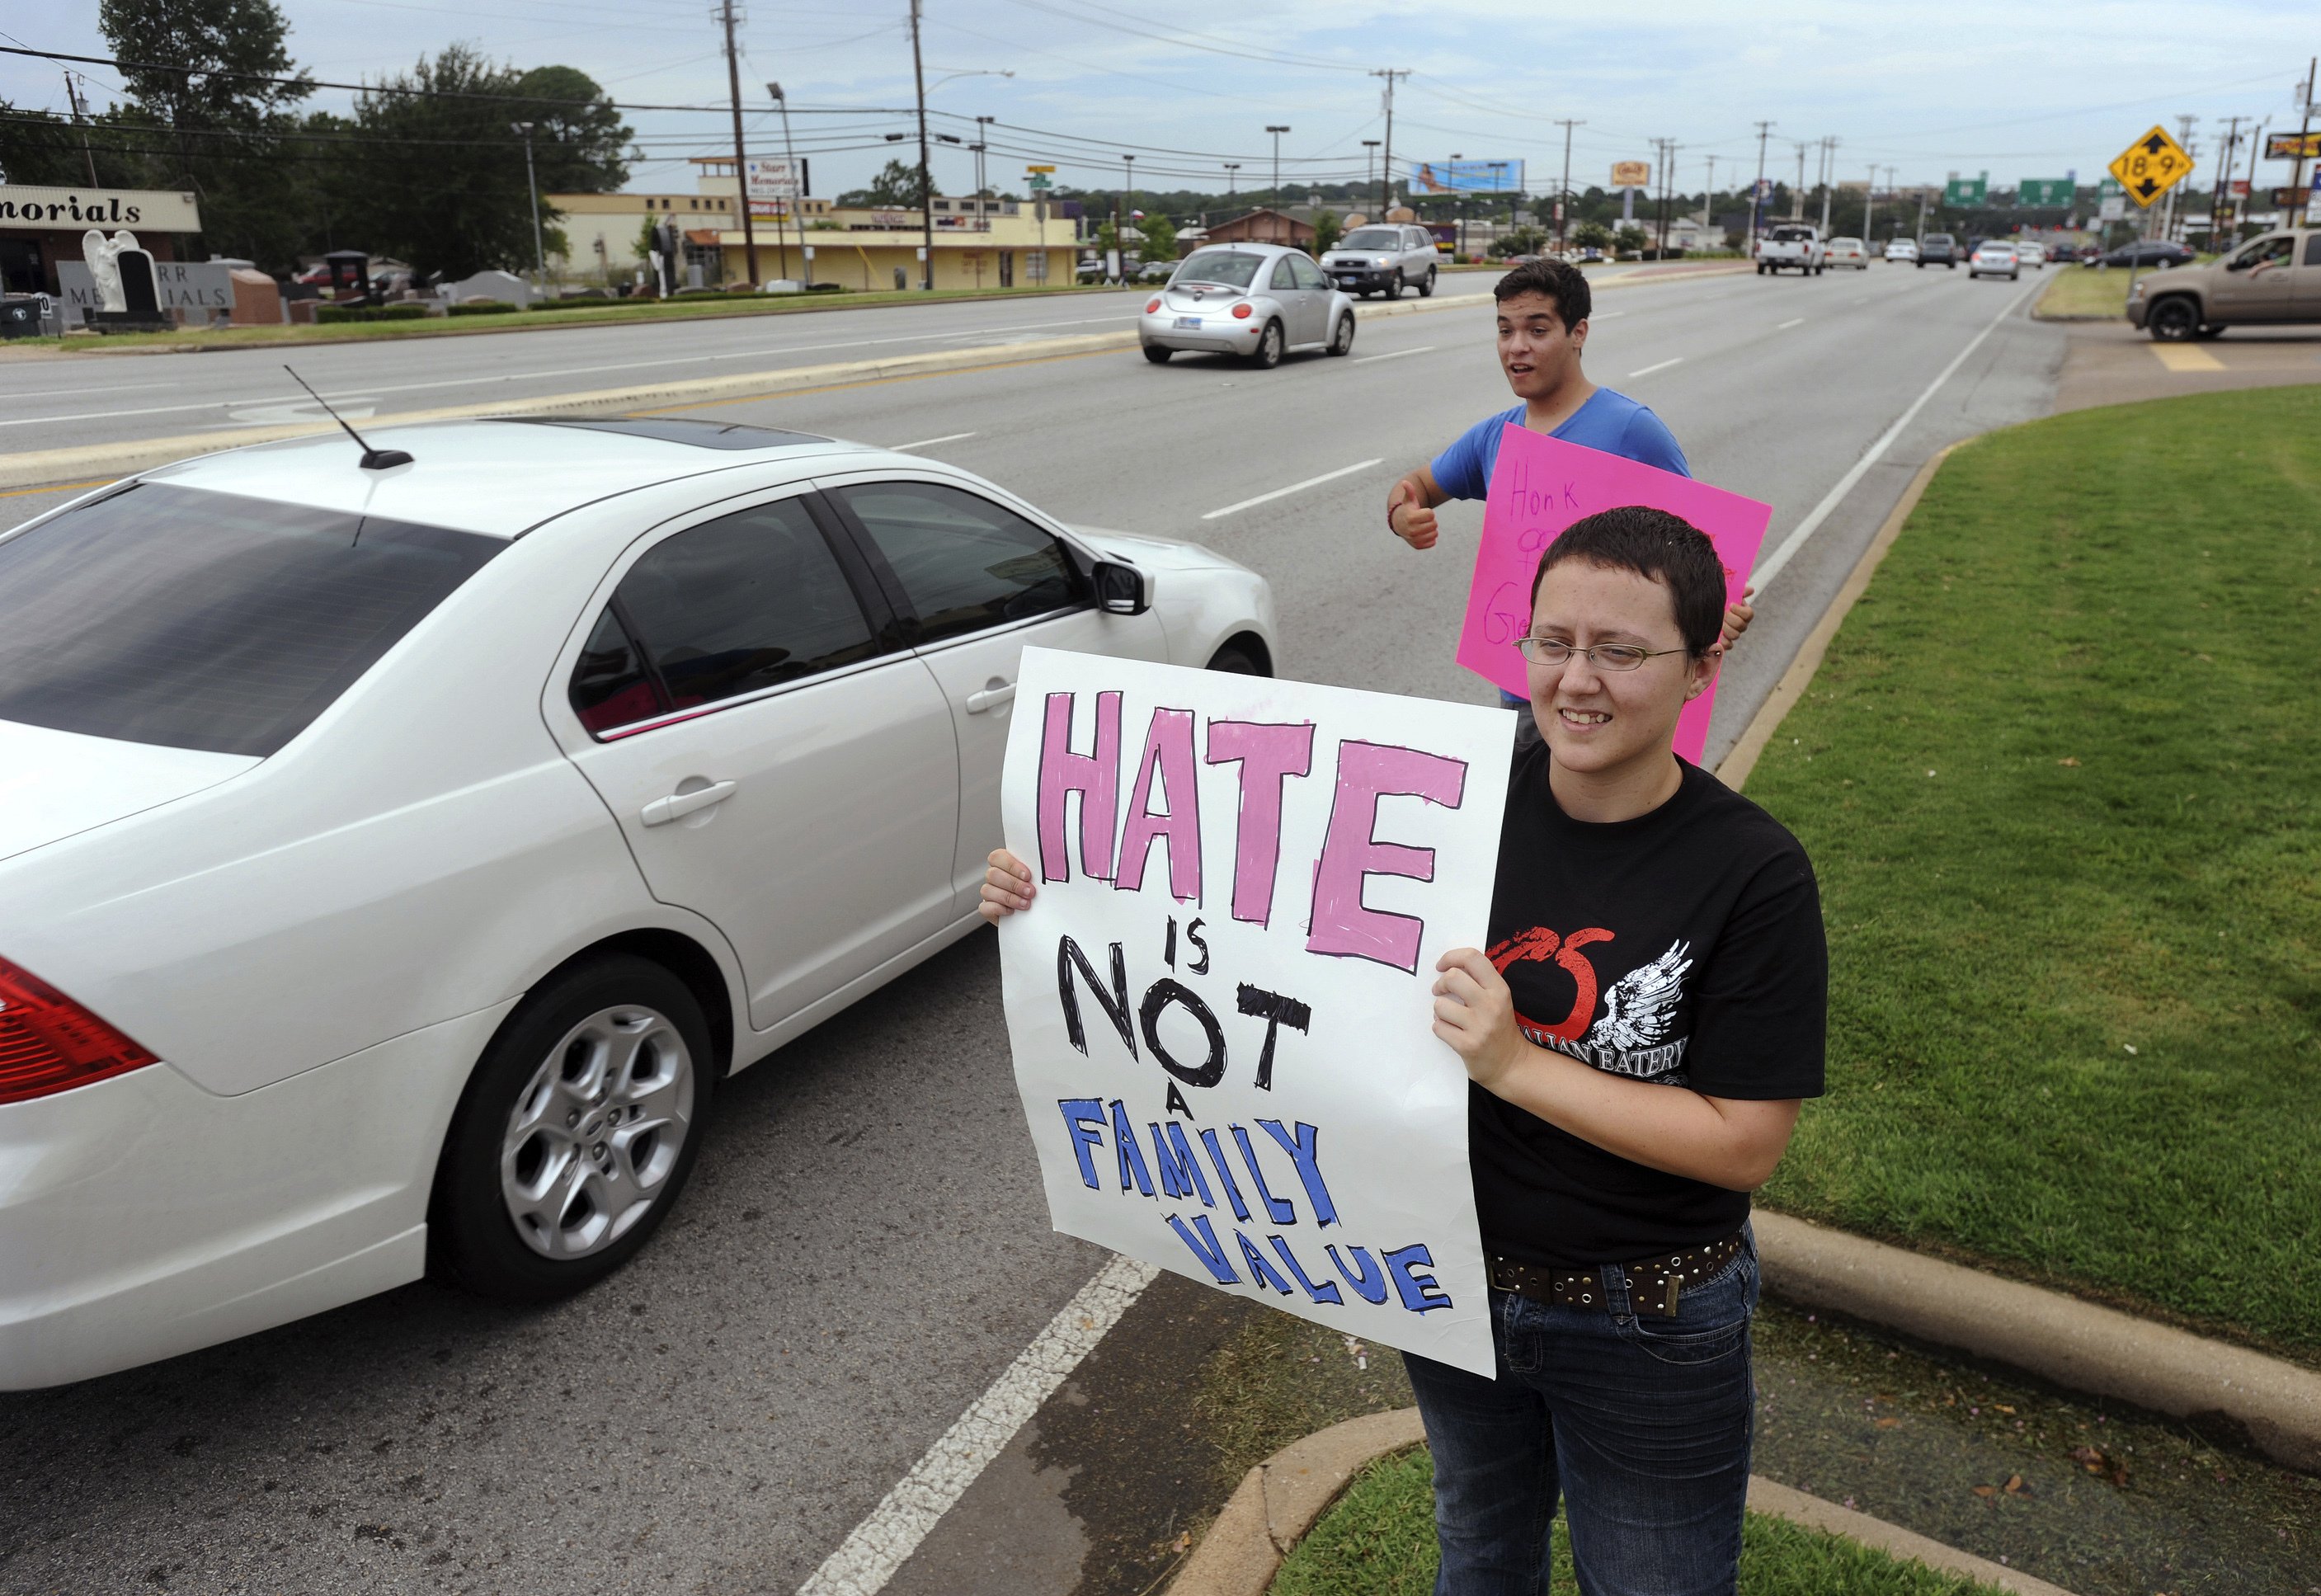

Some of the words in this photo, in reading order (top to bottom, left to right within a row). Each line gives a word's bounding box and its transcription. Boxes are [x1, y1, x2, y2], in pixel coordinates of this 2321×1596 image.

[2122, 156, 2147, 177] 18
[1036, 691, 1468, 976] HATE
[1165, 915, 1210, 975] IS
[1057, 934, 1312, 1092] NOT
[1598, 1035, 1688, 1077] EATERY
[1165, 1077, 1195, 1120] A
[1057, 1097, 1342, 1229] FAMILY
[1160, 1212, 1453, 1316] VALUE
